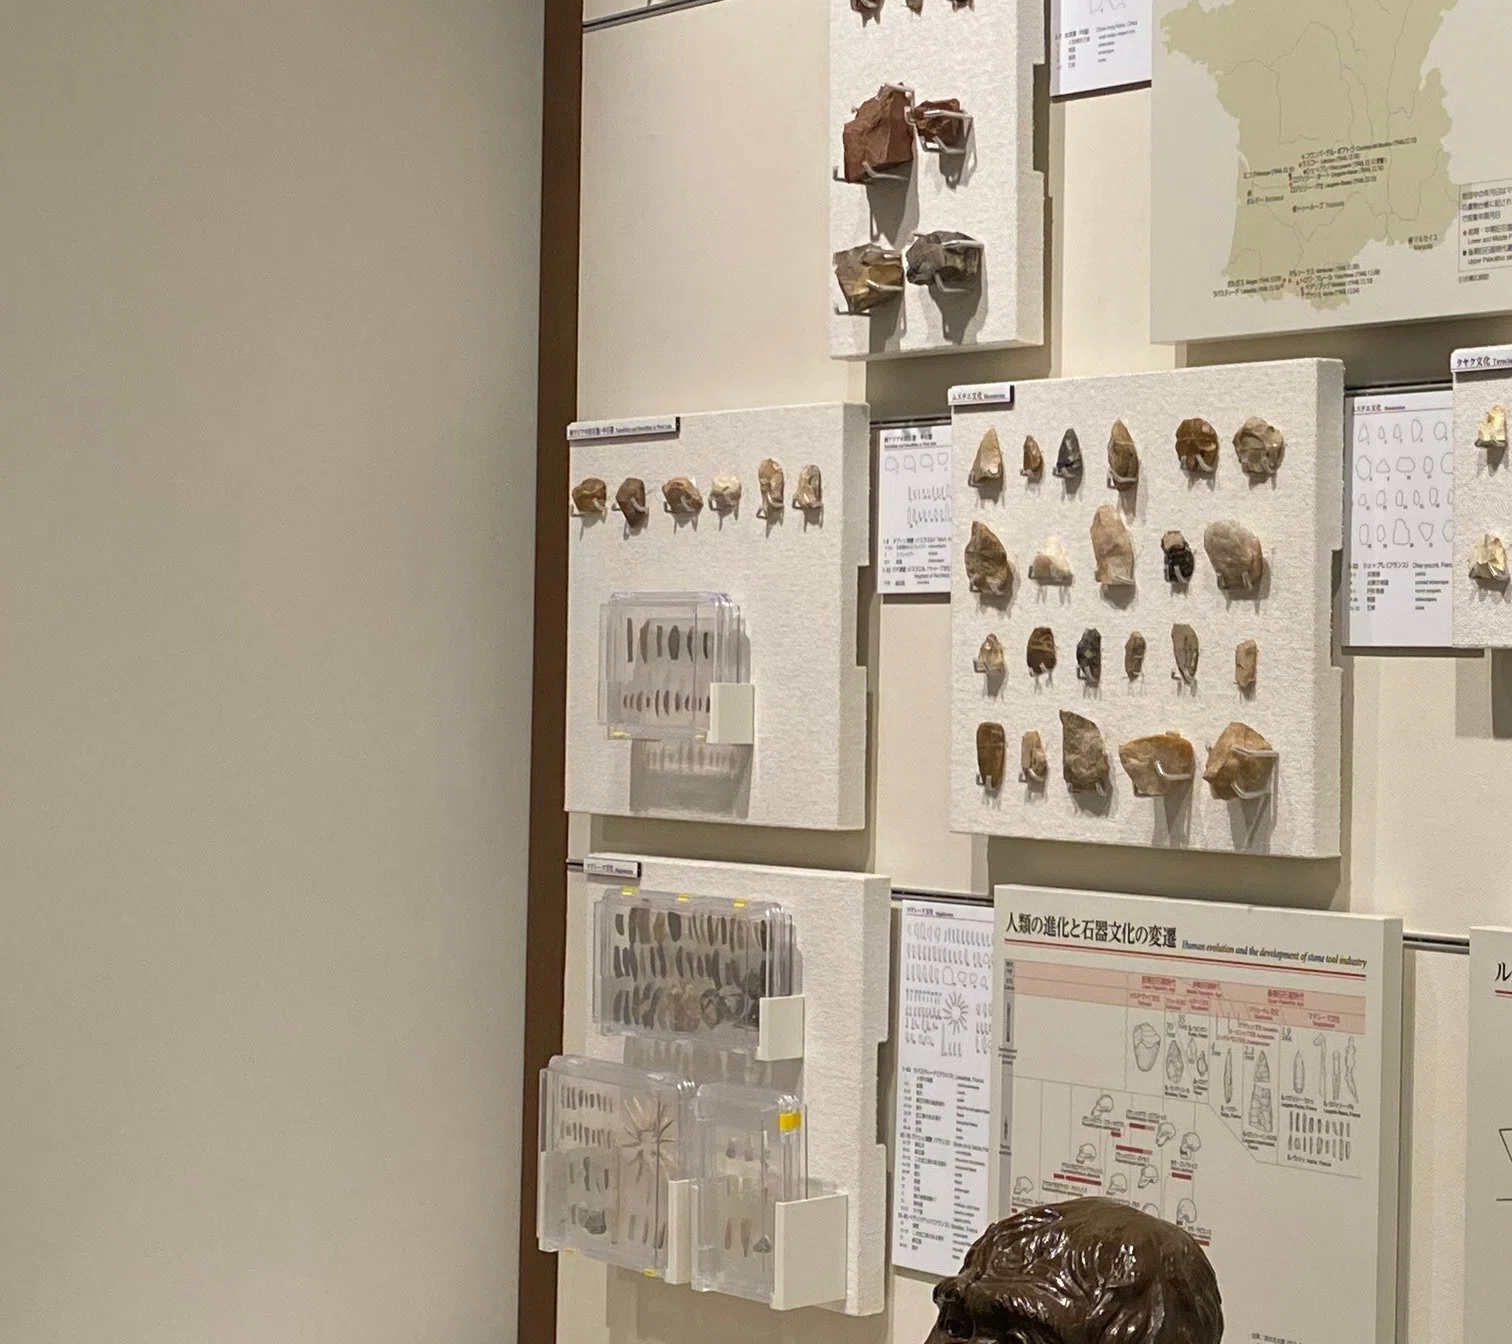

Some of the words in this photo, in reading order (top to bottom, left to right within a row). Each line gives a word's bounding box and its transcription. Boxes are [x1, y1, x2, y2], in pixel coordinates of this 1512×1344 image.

[1457, 356, 1490, 367] タヤク文化
[1006, 913, 1177, 948] 人類の進化と石器文化の変遷
[1206, 942, 1234, 954] evolution
[1236, 945, 1247, 955] and
[1249, 946, 1259, 955] the
[1260, 947, 1299, 962] development
[1339, 955, 1367, 968] industry
